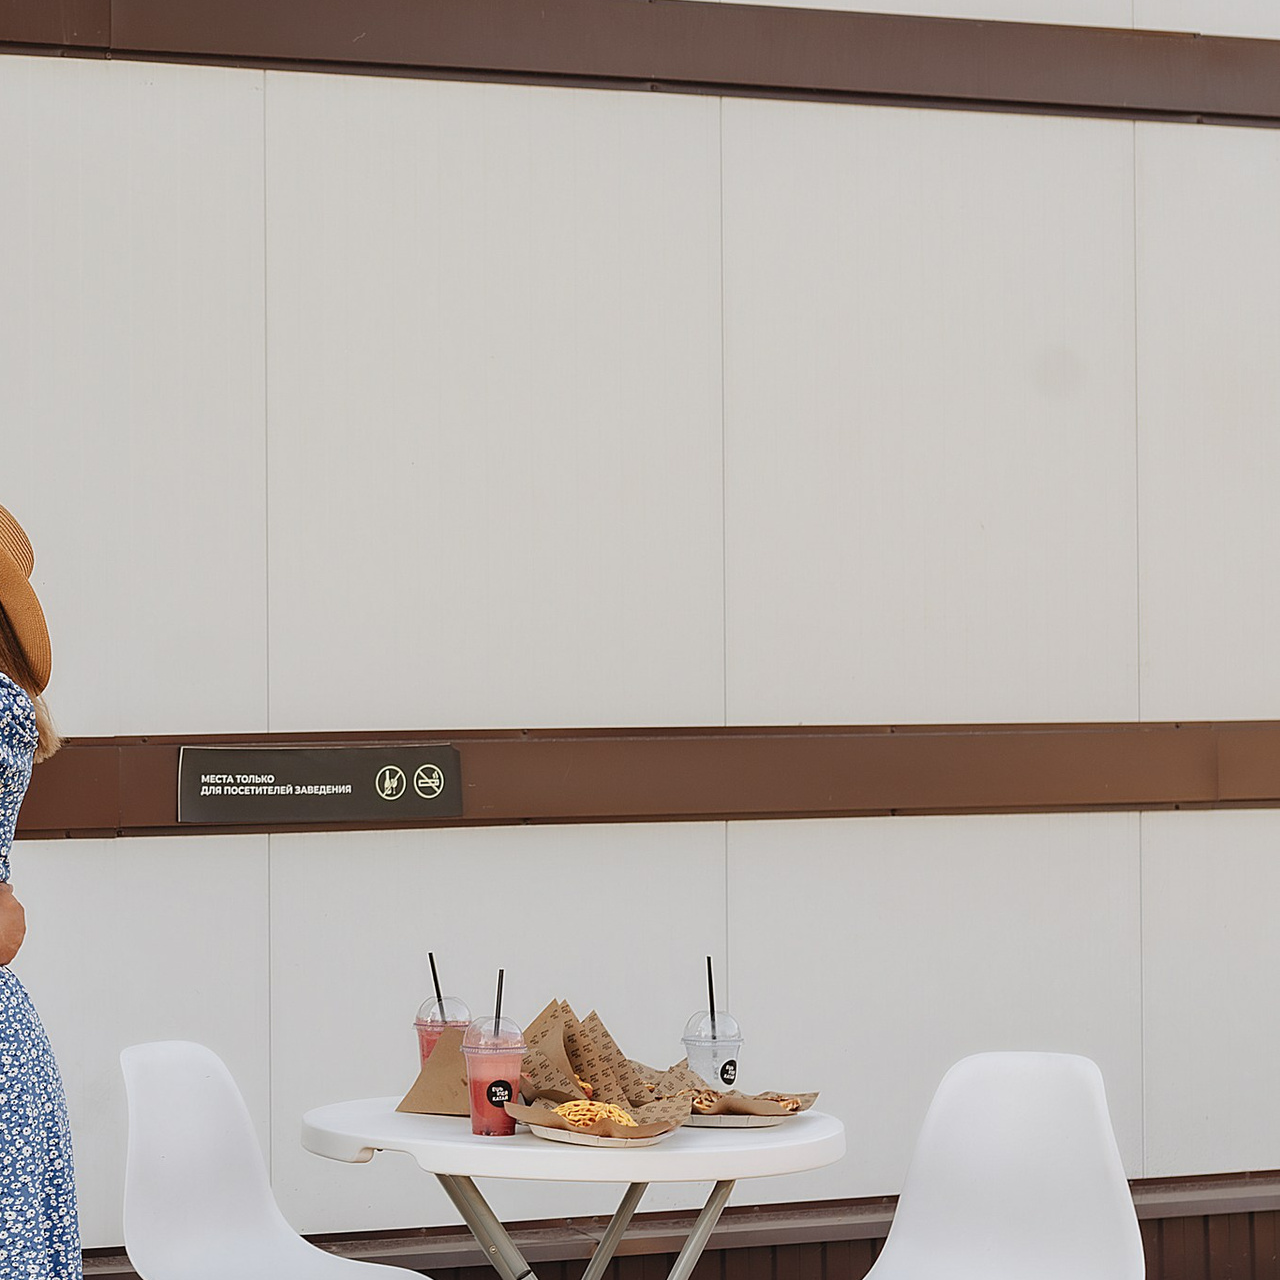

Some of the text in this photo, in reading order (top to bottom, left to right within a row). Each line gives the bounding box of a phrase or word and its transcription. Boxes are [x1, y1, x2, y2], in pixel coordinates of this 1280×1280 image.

[201, 774, 275, 784] МЕСТА ТОЛЬКО
[200, 784, 352, 795] ДЛЯ ПОСЕТИТЕЛЕЙ ЗАВЕДЕНИЯ
